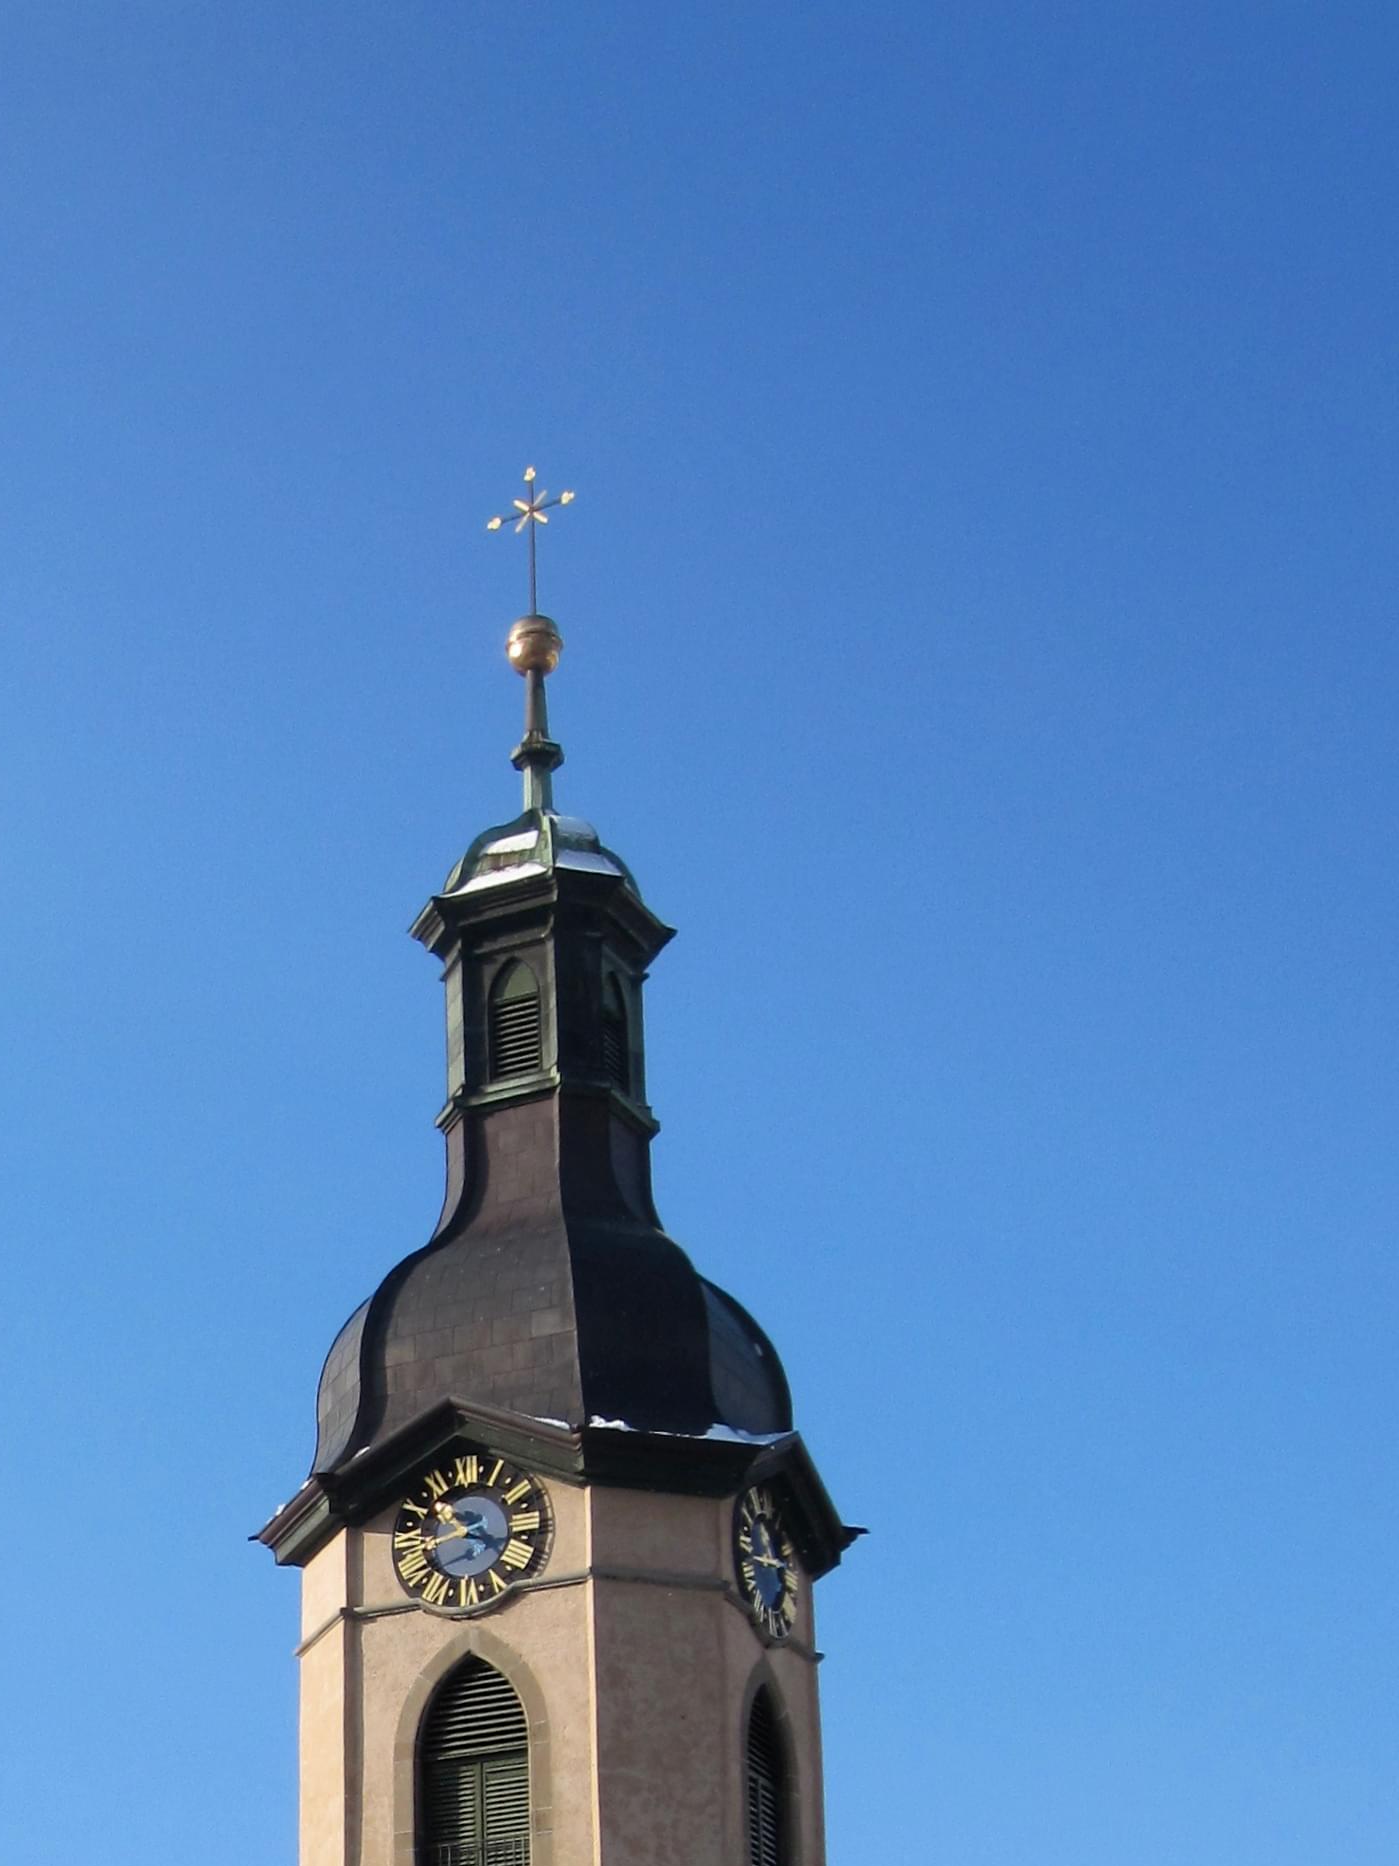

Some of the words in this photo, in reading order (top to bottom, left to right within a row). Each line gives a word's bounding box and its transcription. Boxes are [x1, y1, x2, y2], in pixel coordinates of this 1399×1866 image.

[424, 1469, 449, 1500] XI
[454, 1455, 478, 1486] XII
[487, 1459, 505, 1487] I
[504, 1479, 532, 1505] II
[402, 1498, 429, 1520] X
[509, 1511, 540, 1532] III
[394, 1528, 425, 1549] IX
[500, 1538, 535, 1570] IIII
[398, 1551, 432, 1587] VIII
[488, 1568, 508, 1593] V
[422, 1571, 450, 1606] VII
[460, 1577, 480, 1607] VI
